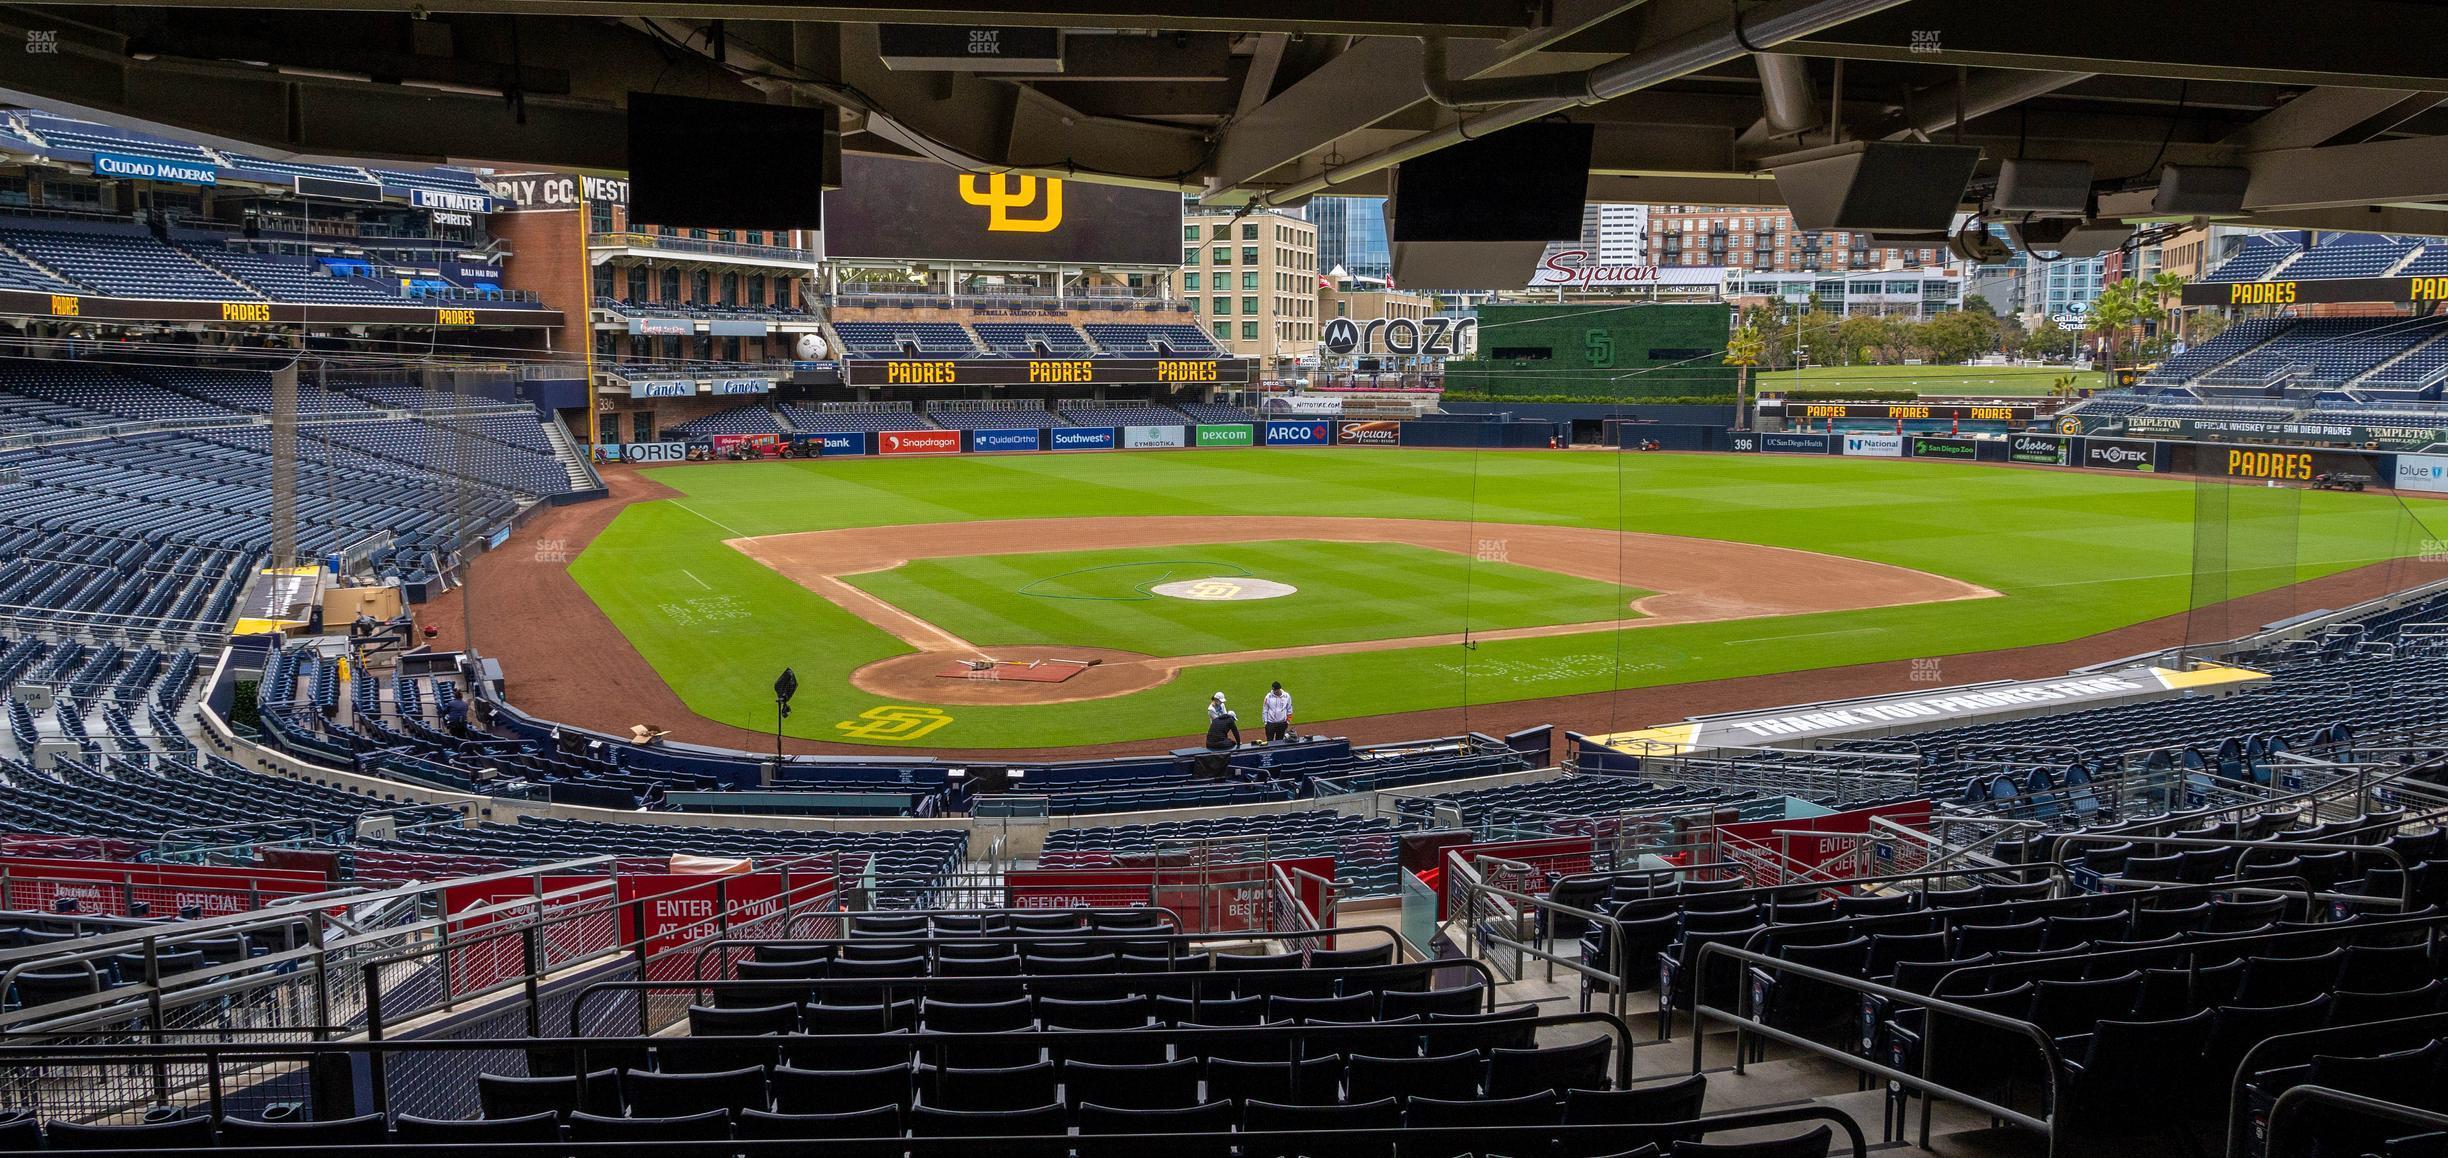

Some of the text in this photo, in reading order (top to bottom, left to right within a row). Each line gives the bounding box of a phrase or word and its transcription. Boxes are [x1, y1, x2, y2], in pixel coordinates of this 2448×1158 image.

[99, 158, 215, 182] CIUDAD MADERAS
[543, 179, 580, 204] CO.
[583, 176, 629, 201] WEST
[421, 190, 484, 212] CUTWATER
[433, 212, 472, 226] SPIRITS
[1544, 250, 1661, 291] Sycuan
[2231, 282, 2297, 304] PADRES
[51, 295, 79, 316] PADRES
[222, 303, 270, 321] PADRES
[439, 309, 475, 325] PADRES
[1363, 318, 1477, 355] razr
[888, 362, 955, 383] PADRES
[1029, 361, 1092, 382] PADRES
[1159, 360, 1216, 381] PADRES
[644, 382, 685, 397] Canel's
[724, 379, 760, 394] Canel's
[599, 398, 614, 411] 336
[1807, 405, 1846, 417] PADRES
[1889, 407, 1929, 418] PADRES
[1971, 408, 2013, 419] PADRES
[2128, 417, 2181, 429] TEMPLETON
[2194, 421, 2228, 431] OFFICIAL
[2229, 422, 2264, 432] WHISKEY
[2283, 424, 2299, 434] SAN
[2300, 425, 2321, 435] DIEGO
[2323, 426, 2352, 436] PADRES
[989, 435, 1036, 446] QuidelOrtho
[1055, 433, 1104, 444] Southwest
[1268, 427, 1311, 440] ARCO
[1341, 423, 1393, 443] Sycuan
[2366, 427, 2436, 440] TEMPLETON
[824, 438, 850, 448] bank
[902, 436, 955, 449] Snapdragon
[1734, 439, 1752, 450] 396
[1767, 438, 1777, 446] UC
[1788, 439, 1805, 448] Diego
[1805, 440, 1823, 448] Health
[1864, 439, 1899, 448] National
[1928, 444, 1974, 454] San Diego Zoo
[2015, 437, 2056, 451] Chosen
[630, 444, 683, 460] ORIS
[2091, 447, 2147, 462] EVOTEK
[2228, 449, 2313, 481] PADRES
[2400, 464, 2429, 477] blue
[1731, 676, 2144, 736] THANK YOU PADRES FANS
[370, 828, 386, 839] 101
[1820, 836, 1856, 854] ENTER
[1881, 847, 1887, 856] K
[2082, 876, 2089, 885] J
[79, 901, 104, 914] SEAT
[175, 892, 242, 912] OFFICIAL
[656, 899, 713, 917] ENTER
[744, 896, 777, 916] WIN
[1229, 902, 1258, 916] BEST
[657, 923, 678, 940] AT
